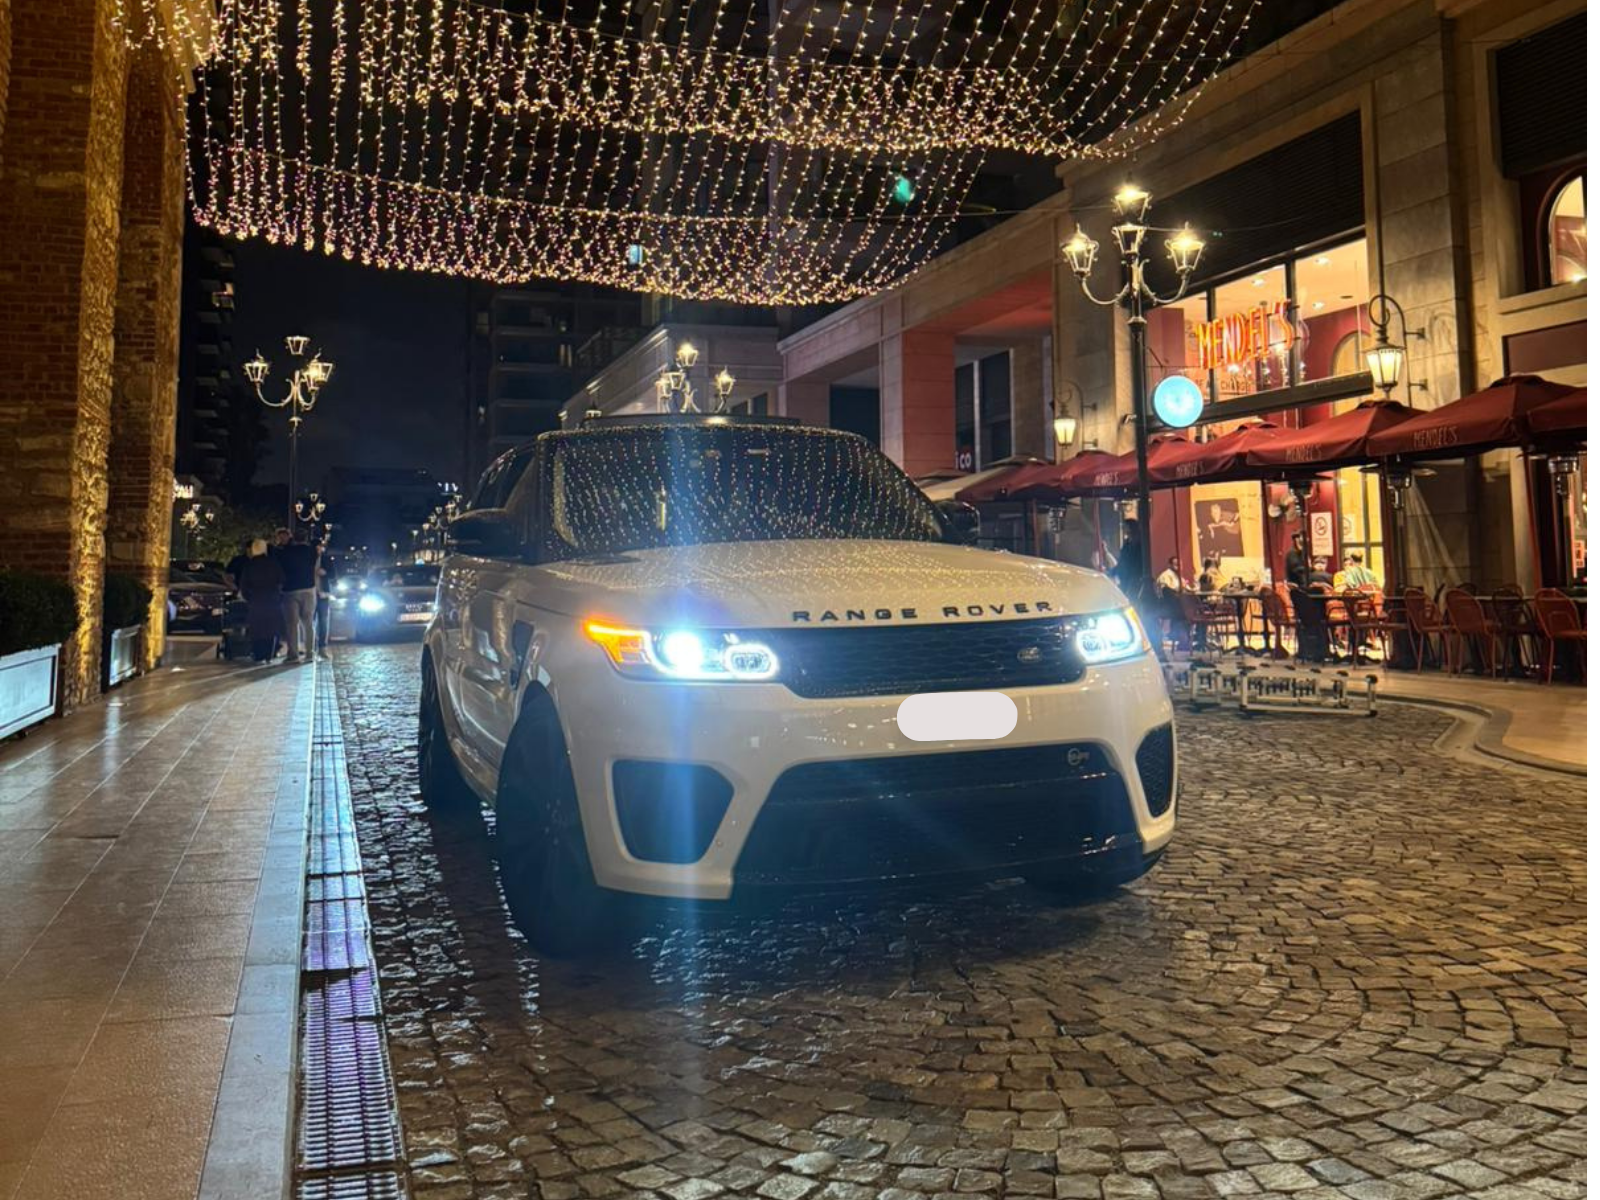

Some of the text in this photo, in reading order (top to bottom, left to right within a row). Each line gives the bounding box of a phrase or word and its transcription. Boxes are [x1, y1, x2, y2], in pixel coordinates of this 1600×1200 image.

[1195, 300, 1295, 370] MENDEL'S
[1413, 426, 1458, 448] MENDEL'S
[1285, 443, 1322, 462] MENDEL'S
[792, 601, 1053, 622] RANGE ROVER
